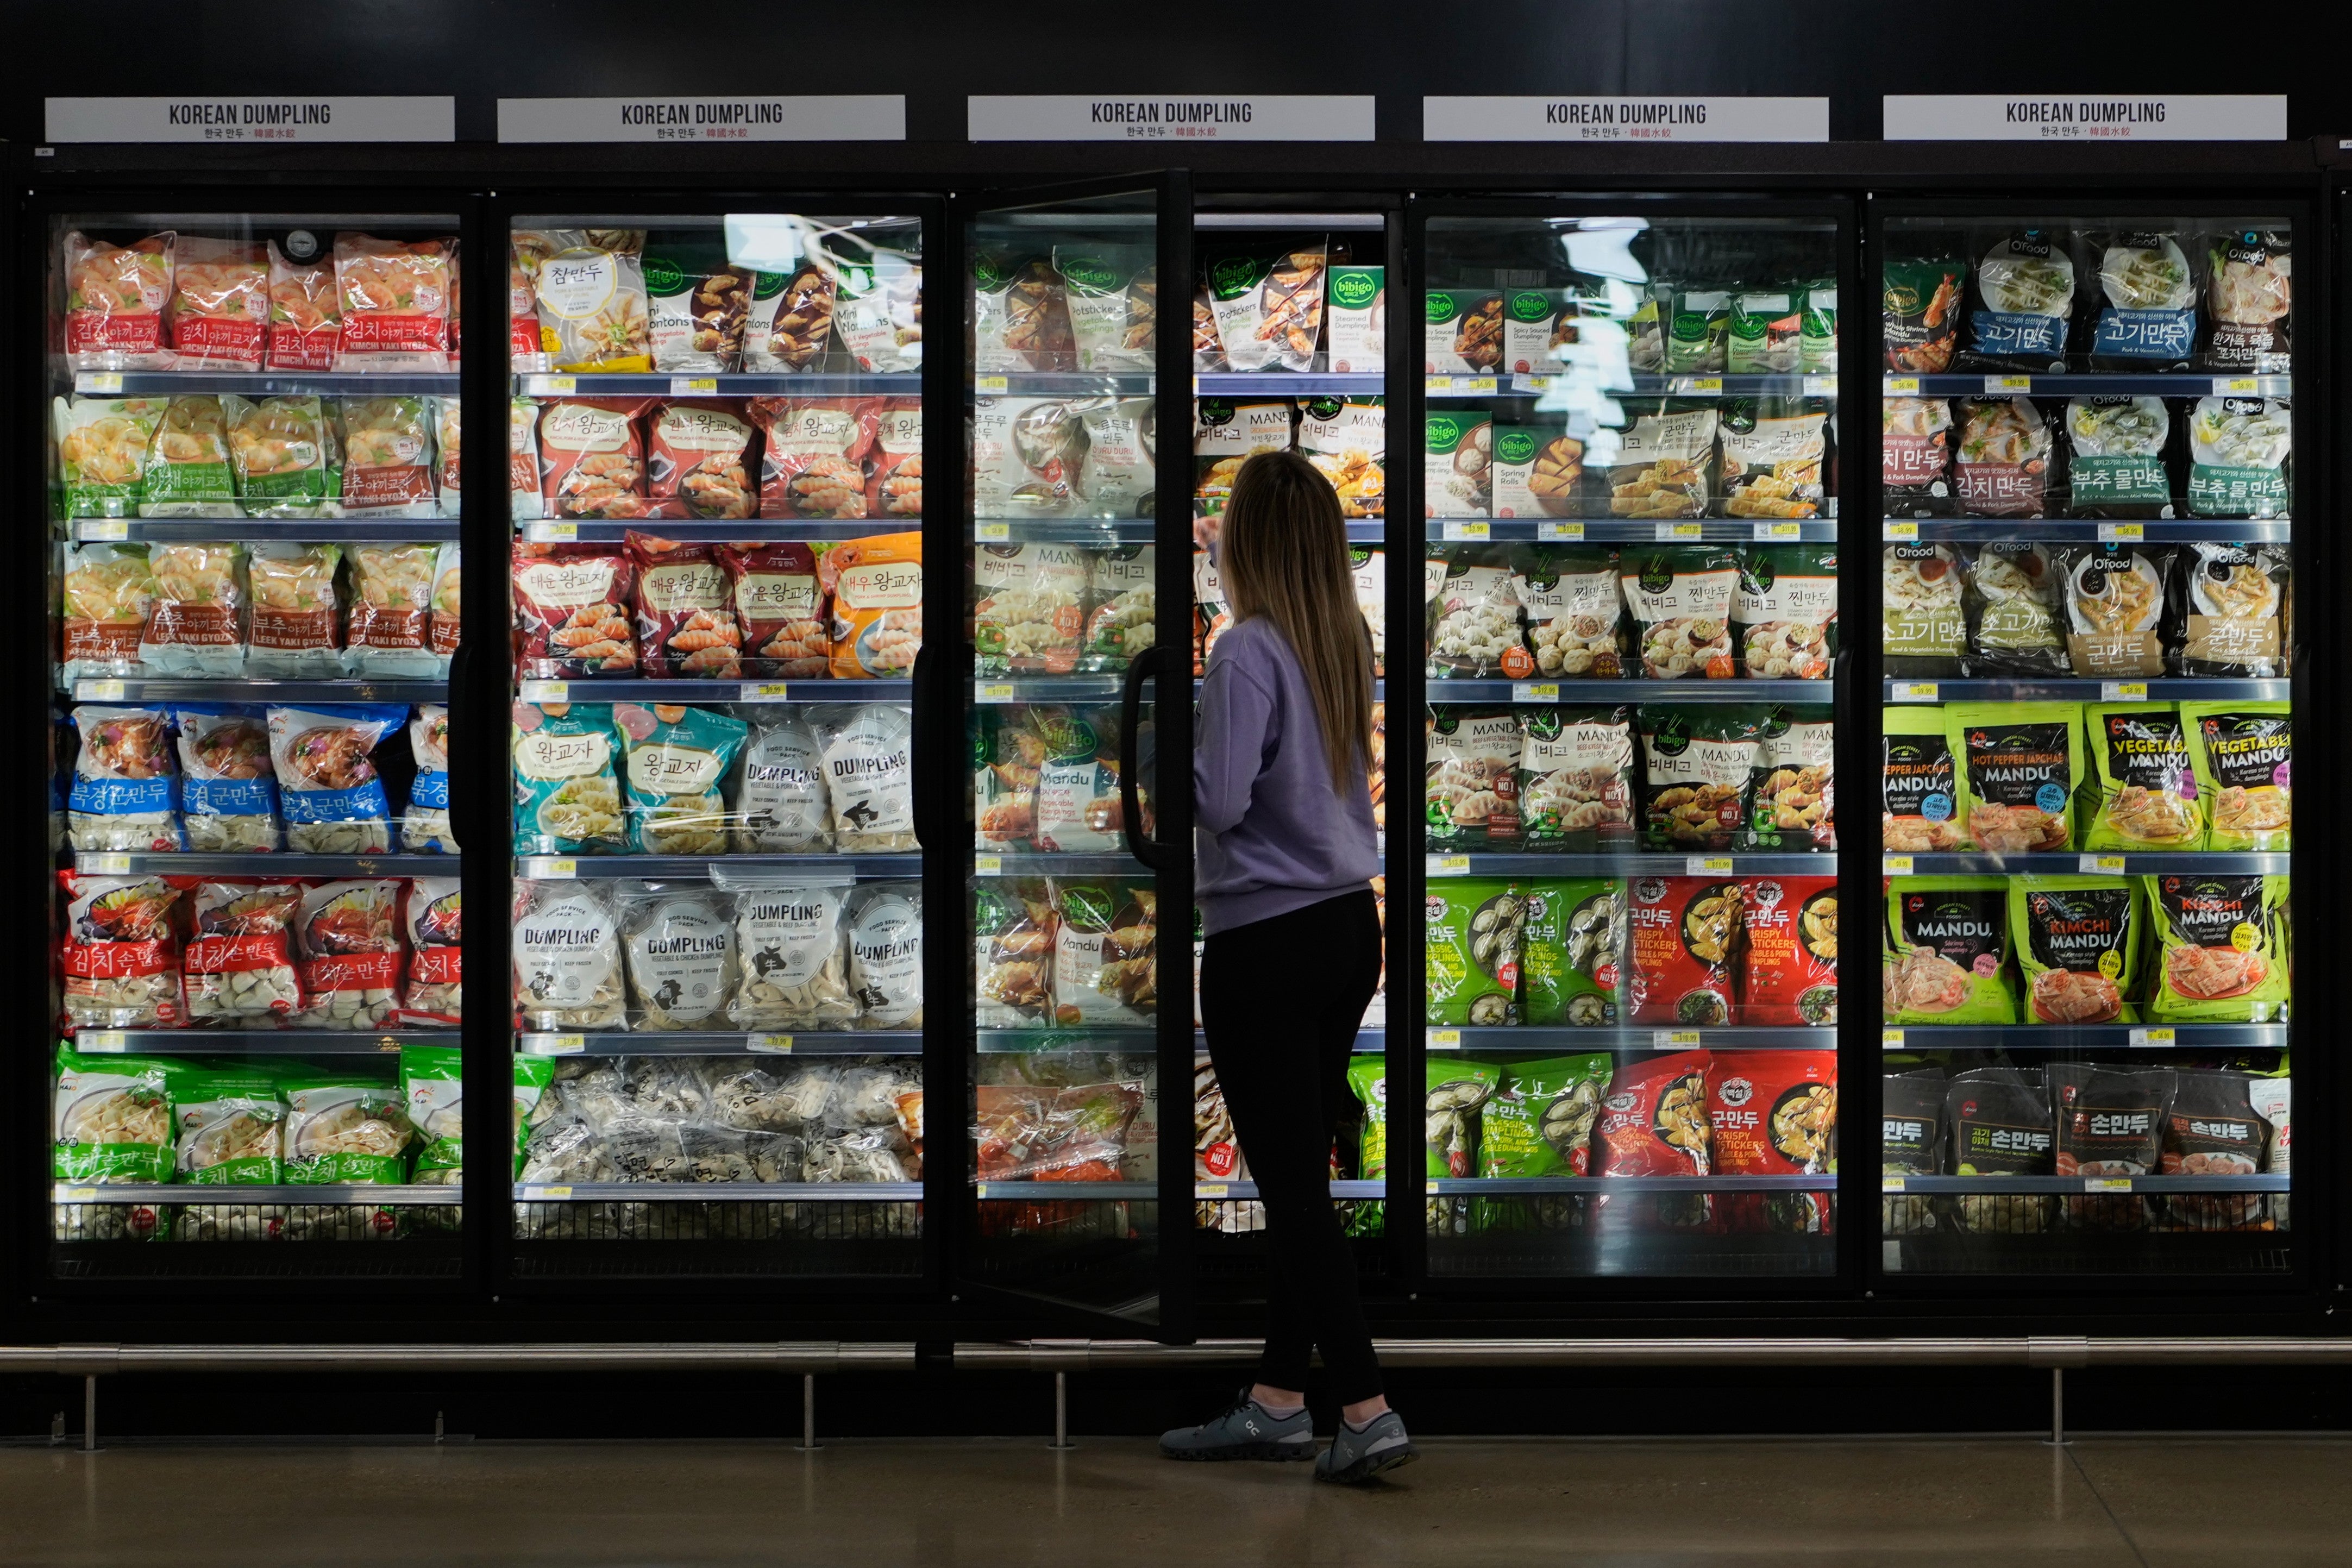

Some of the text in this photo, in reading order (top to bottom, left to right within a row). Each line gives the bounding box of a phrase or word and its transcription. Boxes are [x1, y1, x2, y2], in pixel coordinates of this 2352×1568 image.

[170, 104, 331, 124] KOREAN DUMPLING
[622, 103, 783, 124] KOREAN DUMPLING
[1092, 103, 1252, 123] KOREAN DUMPLING
[1546, 104, 1707, 124] KOREAN DUMPLING
[2006, 102, 2166, 122] KOREAN DUMPLING
[204, 128, 296, 139] 한국 만두 韓國水餃
[656, 128, 748, 139] 한국 만두 韓國水餃
[1126, 126, 1217, 137] 한국 만두 韓國水餃
[1581, 127, 1672, 138] 한국 만두 韓國水餃
[2041, 126, 2131, 137] 한국 만두 韓國水餃
[551, 265, 603, 285] 참만두
[1215, 261, 1256, 281] bibigo
[1338, 281, 1372, 294] bibigo
[1516, 299, 1546, 311] bibigo
[1888, 293, 1918, 304] bibigo
[182, 323, 206, 342] 김치
[1676, 319, 1704, 332] bibigo
[1501, 441, 1532, 453] bibigo
[1501, 469, 1525, 479] Spring
[983, 560, 1026, 577] 비비고
[530, 573, 559, 590] 매운
[873, 572, 922, 591] 왕교자
[1530, 573, 1556, 582] bibigo
[1642, 574, 1669, 584] bibigo
[651, 577, 676, 594] 매운
[1688, 586, 1729, 602] 찐만두
[1788, 591, 1829, 605] 찐만두
[1641, 596, 1677, 609] 비비고
[256, 617, 287, 635] 부추
[256, 635, 277, 645] LEEK
[280, 636, 299, 645] YAKI
[369, 636, 388, 645] YAKI
[1508, 656, 1528, 669] NO.1
[1658, 734, 1685, 744] bibigo
[535, 741, 593, 762] 왕교자
[1702, 748, 1750, 762] MANDU
[2222, 748, 2285, 769] MANDU
[644, 753, 703, 776] 왕교자
[833, 751, 906, 776] DUMPLING
[1649, 758, 1691, 772] 비비고
[1972, 754, 2064, 765] HOT PEPPER JAPCHAE
[2129, 754, 2188, 768] MANDU
[748, 763, 819, 781] DUMPLING
[1985, 766, 2049, 782] MANDU
[1721, 811, 1738, 820] NO.1
[1641, 884, 1658, 896] 백설
[2181, 910, 2243, 925] MANDU
[525, 928, 600, 944] DUMPLING
[1917, 922, 1989, 937] MANDU
[648, 934, 725, 955] DUMPLING
[2050, 933, 2111, 949] MANDU
[855, 938, 918, 960] DUMPLING
[1728, 1087, 1745, 1099] 백설
[1711, 1112, 1759, 1130] 군만두
[2091, 1114, 2148, 1134] 손만두
[1718, 1131, 1749, 1140] CRISPY
[2191, 1121, 2248, 1140] 손만두
[1991, 1130, 2050, 1151] 손만두
[1211, 1152, 1231, 1168] NO.1
